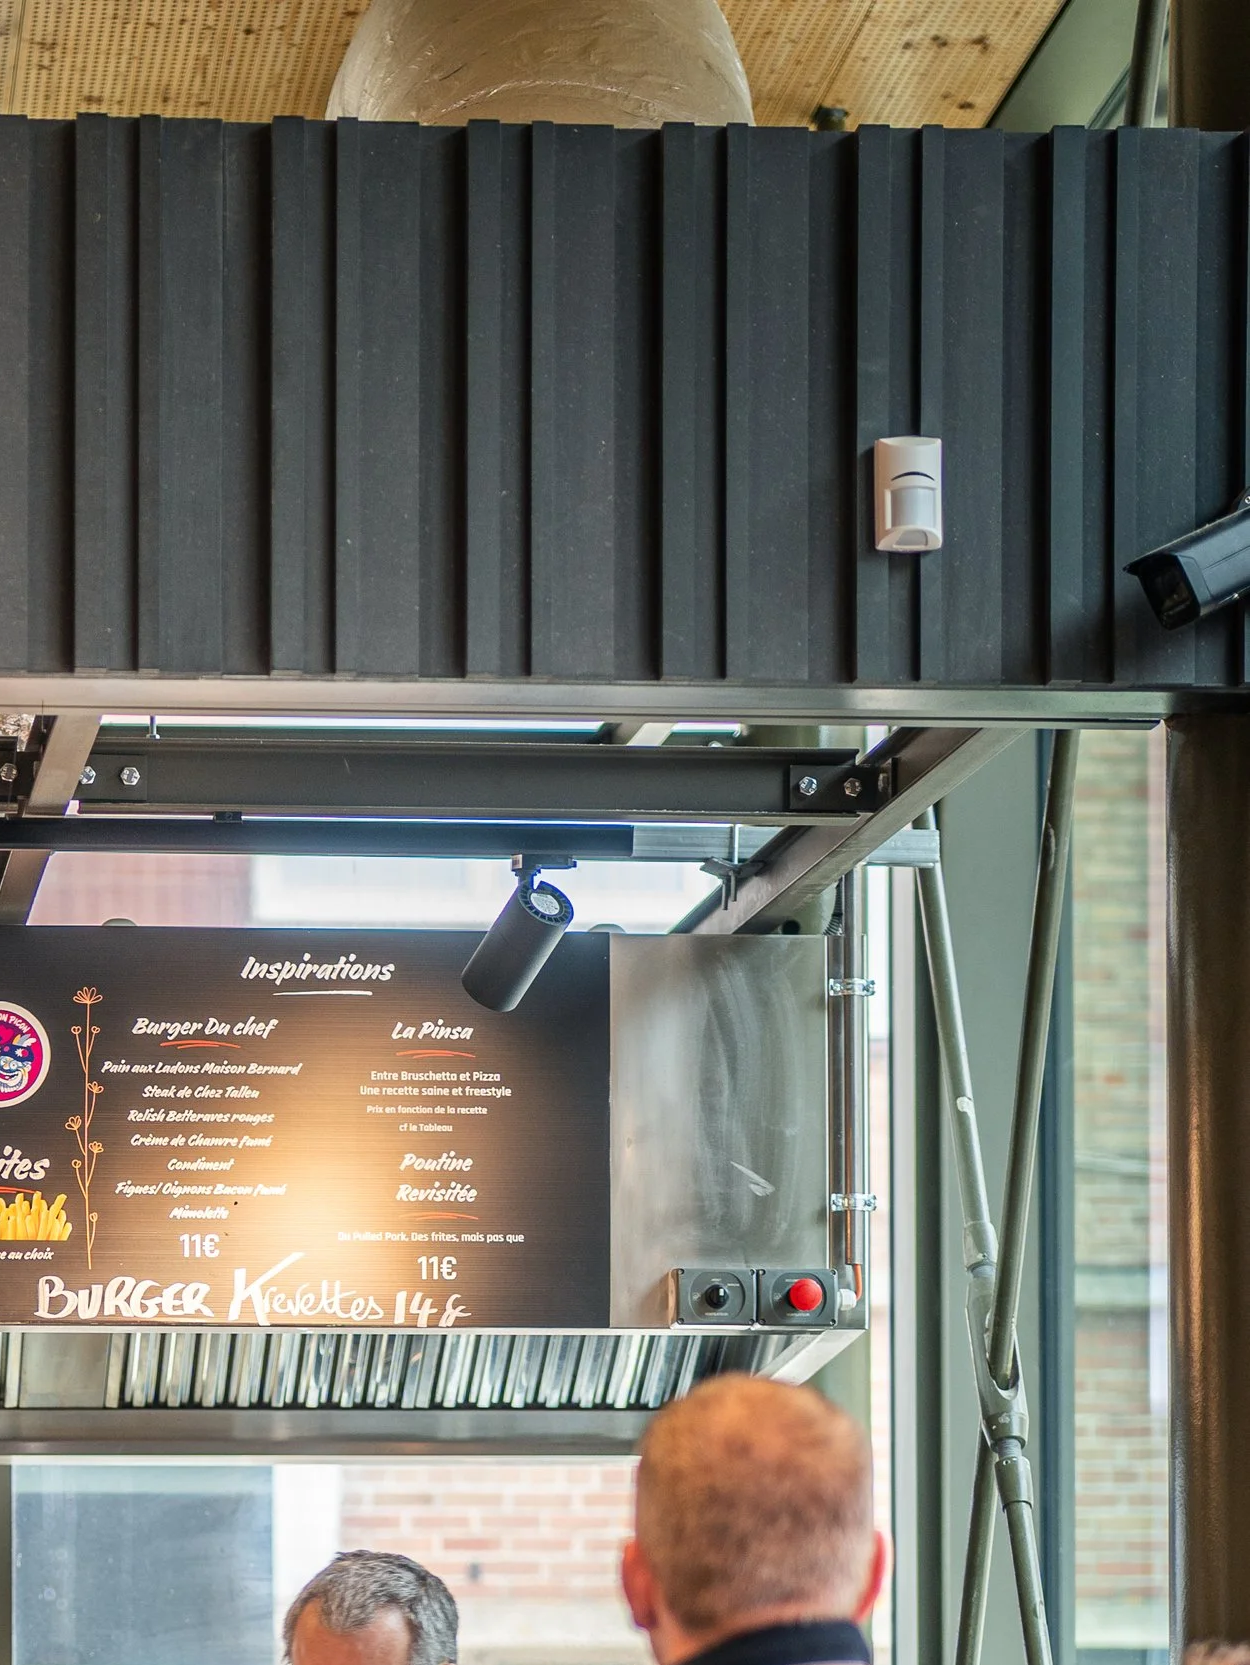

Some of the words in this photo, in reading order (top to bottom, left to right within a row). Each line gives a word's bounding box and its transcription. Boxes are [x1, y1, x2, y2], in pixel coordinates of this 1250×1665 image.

[240, 953, 395, 985] Inspirations
[9, 1013, 31, 1033] PICON
[132, 1017, 201, 1040] Burger
[204, 1018, 232, 1036] Du
[233, 1016, 279, 1039] chef
[391, 1021, 416, 1039] La
[418, 1019, 474, 1040] Pinsa
[101, 1060, 130, 1074] Pain
[131, 1064, 155, 1074] aux
[155, 1062, 201, 1074] Ladons
[200, 1061, 247, 1075] Maison
[247, 1063, 303, 1075] Bernard
[371, 1071, 398, 1081] Entre
[400, 1071, 457, 1081] Bruschetta
[459, 1071, 470, 1081] et
[472, 1071, 501, 1081] Pizza
[142, 1085, 177, 1099] Steak
[177, 1086, 191, 1099] de
[194, 1085, 222, 1099] Chez
[360, 1086, 379, 1095] Une
[382, 1086, 419, 1096] recette
[422, 1086, 449, 1096] saine
[452, 1086, 463, 1096] et
[465, 1086, 512, 1098] freestyle
[128, 1108, 165, 1122] Relish
[166, 1110, 230, 1123] Betteraves
[231, 1112, 275, 1126] rouges
[366, 1105, 383, 1114] Prix
[385, 1106, 396, 1114] en
[398, 1105, 433, 1114] fonction
[435, 1106, 445, 1114] de
[447, 1106, 456, 1114] la
[457, 1106, 488, 1115] recette
[399, 1123, 408, 1132] cf
[409, 1123, 417, 1132] le
[419, 1123, 453, 1132] Tableau
[130, 1134, 169, 1147] Crème
[170, 1134, 185, 1147] de
[167, 1157, 235, 1171] Condiment
[399, 1151, 473, 1172] Poutine
[162, 1181, 213, 1198] Oignons
[396, 1181, 478, 1202] Revisitée
[179, 1233, 220, 1258] 11€
[411, 1232, 429, 1242] Des
[431, 1232, 459, 1243] frites,
[461, 1233, 485, 1242] mais
[486, 1234, 504, 1243] pas
[506, 1234, 524, 1243] que
[7, 1250, 22, 1260] au
[23, 1247, 54, 1260] choix
[417, 1256, 457, 1280] 11€
[34, 1275, 215, 1320] BURGER
[227, 1251, 385, 1326] Krevettes
